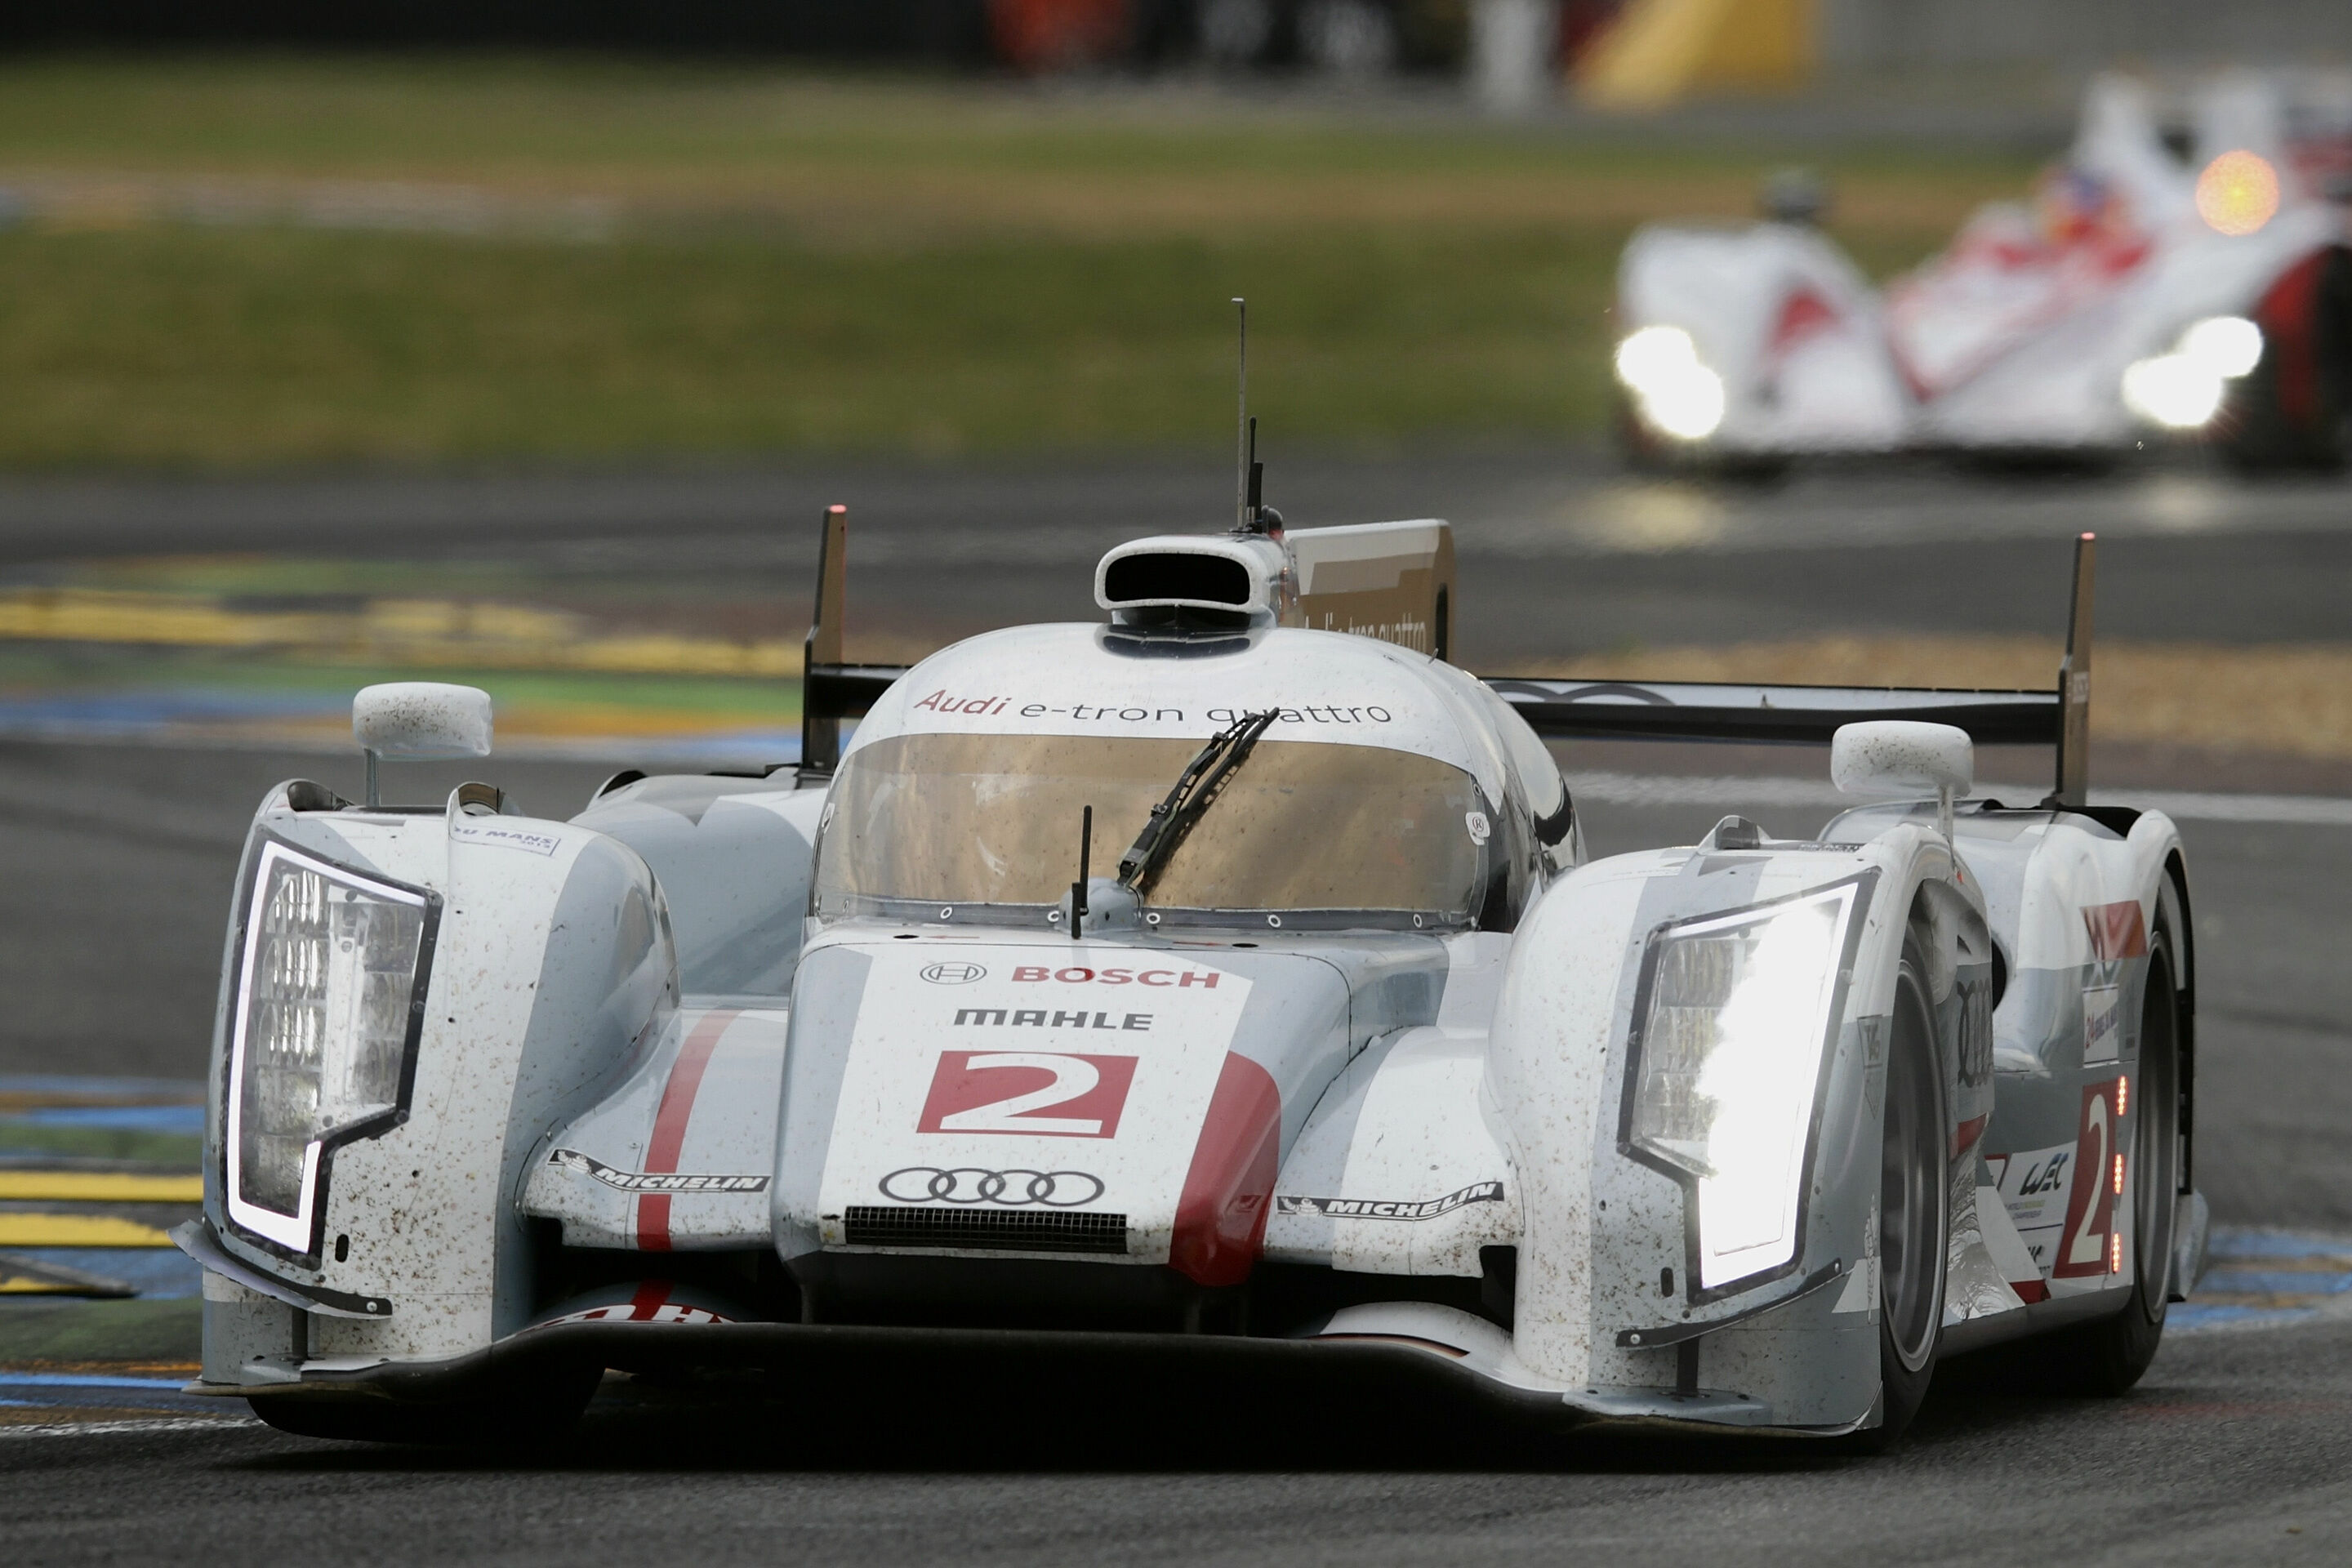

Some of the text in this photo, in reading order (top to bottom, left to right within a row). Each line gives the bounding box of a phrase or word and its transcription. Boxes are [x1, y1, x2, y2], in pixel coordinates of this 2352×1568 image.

[913, 688, 1392, 727] Audi e-tron qattro
[485, 831, 553, 844] MANS
[1011, 966, 1220, 988] BOSCH
[953, 1009, 1153, 1031] MAHLE
[939, 1052, 1100, 1134] 2
[595, 1167, 764, 1189] MICHELIN
[2019, 1152, 2069, 1196] WEC
[2068, 1094, 2108, 1264] 2
[1325, 1183, 1496, 1217] MICHELIN
